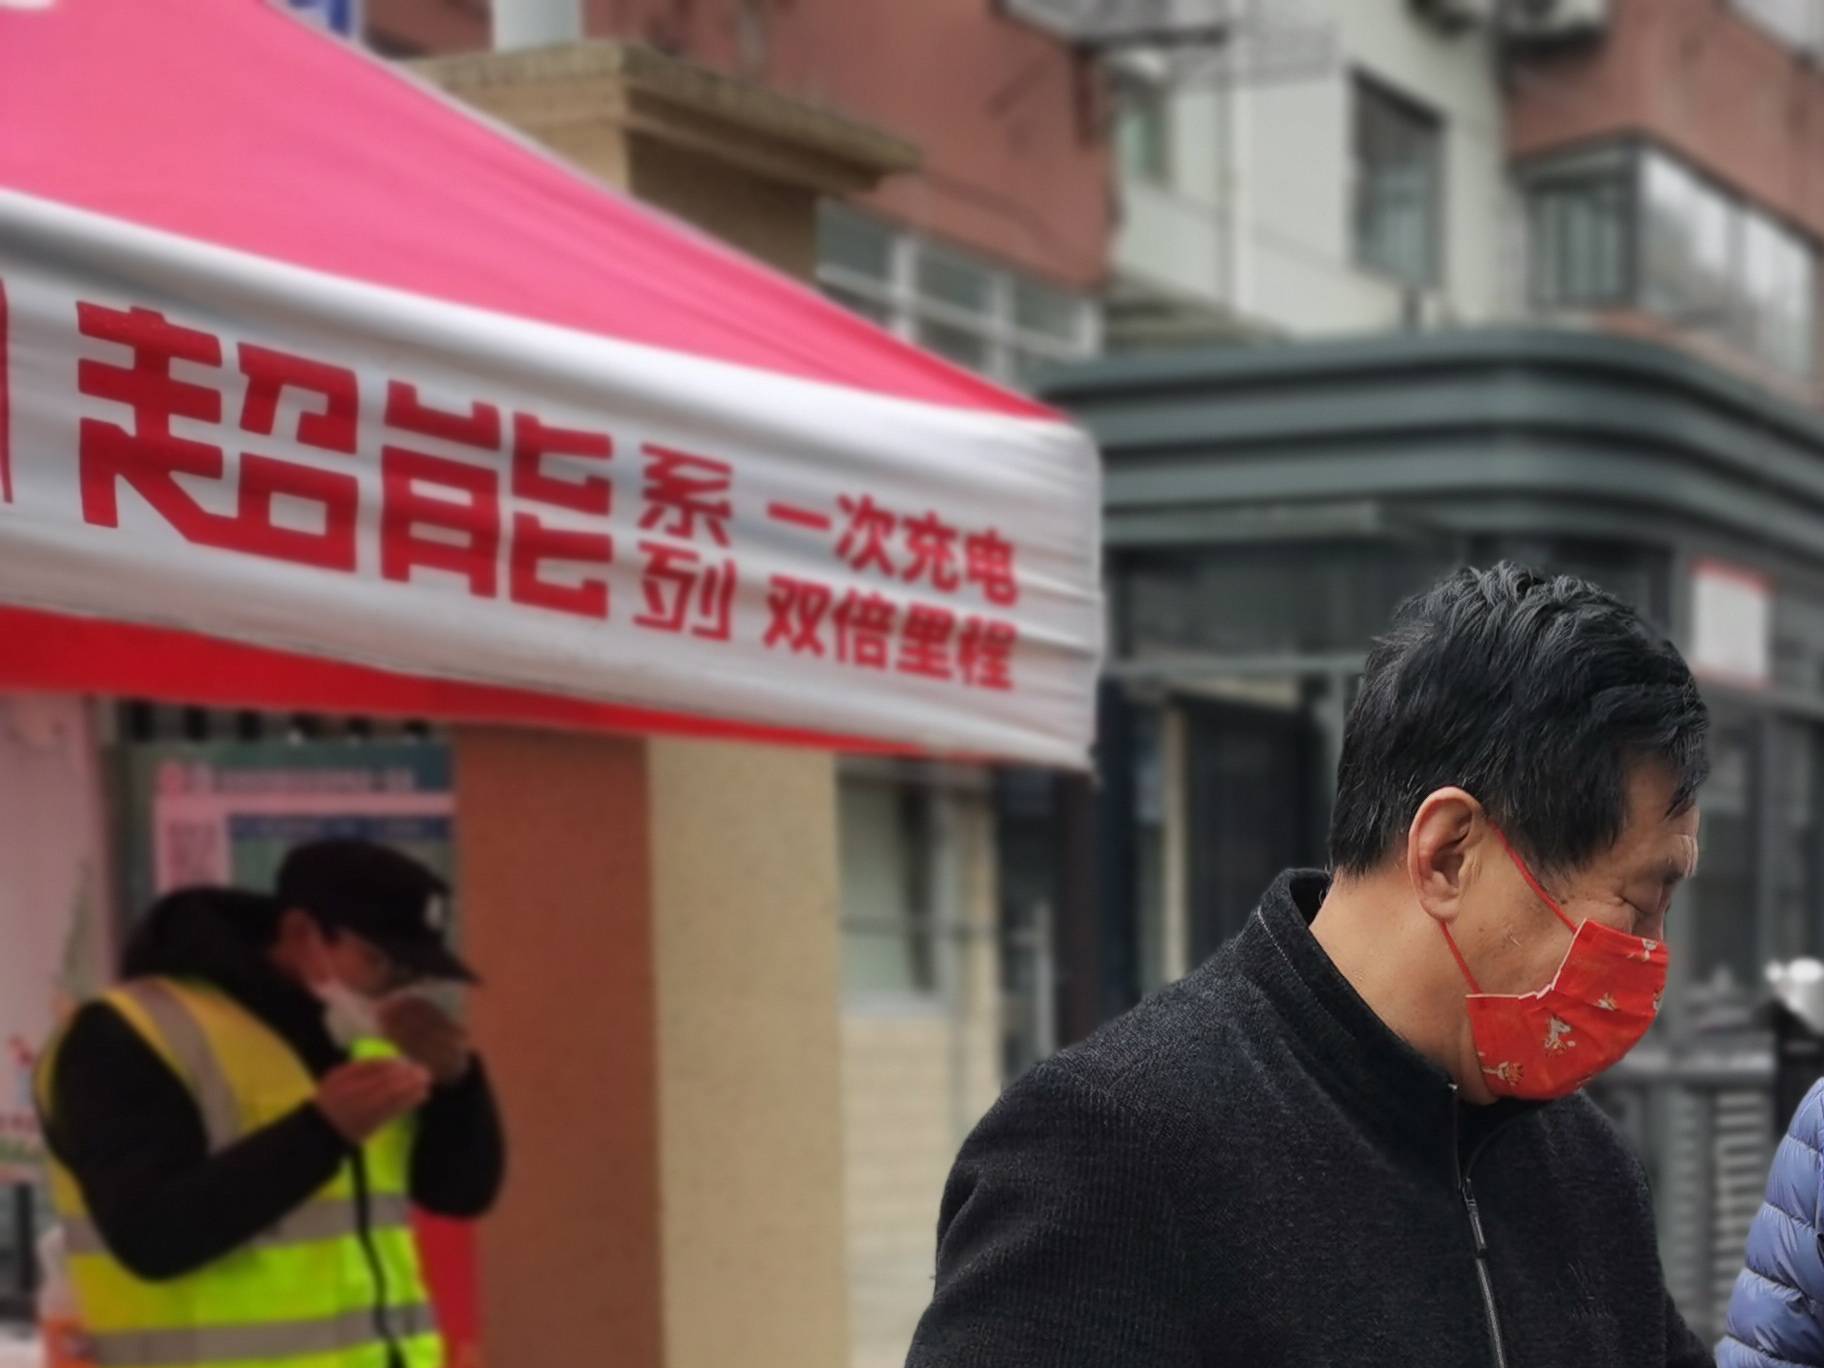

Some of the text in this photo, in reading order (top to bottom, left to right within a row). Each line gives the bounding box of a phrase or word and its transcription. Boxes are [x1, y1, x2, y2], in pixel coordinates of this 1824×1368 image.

[76, 299, 613, 621] 超能
[633, 441, 737, 643] 系列
[767, 494, 1020, 608] 一次充电
[763, 572, 1018, 692] 双倍里程
